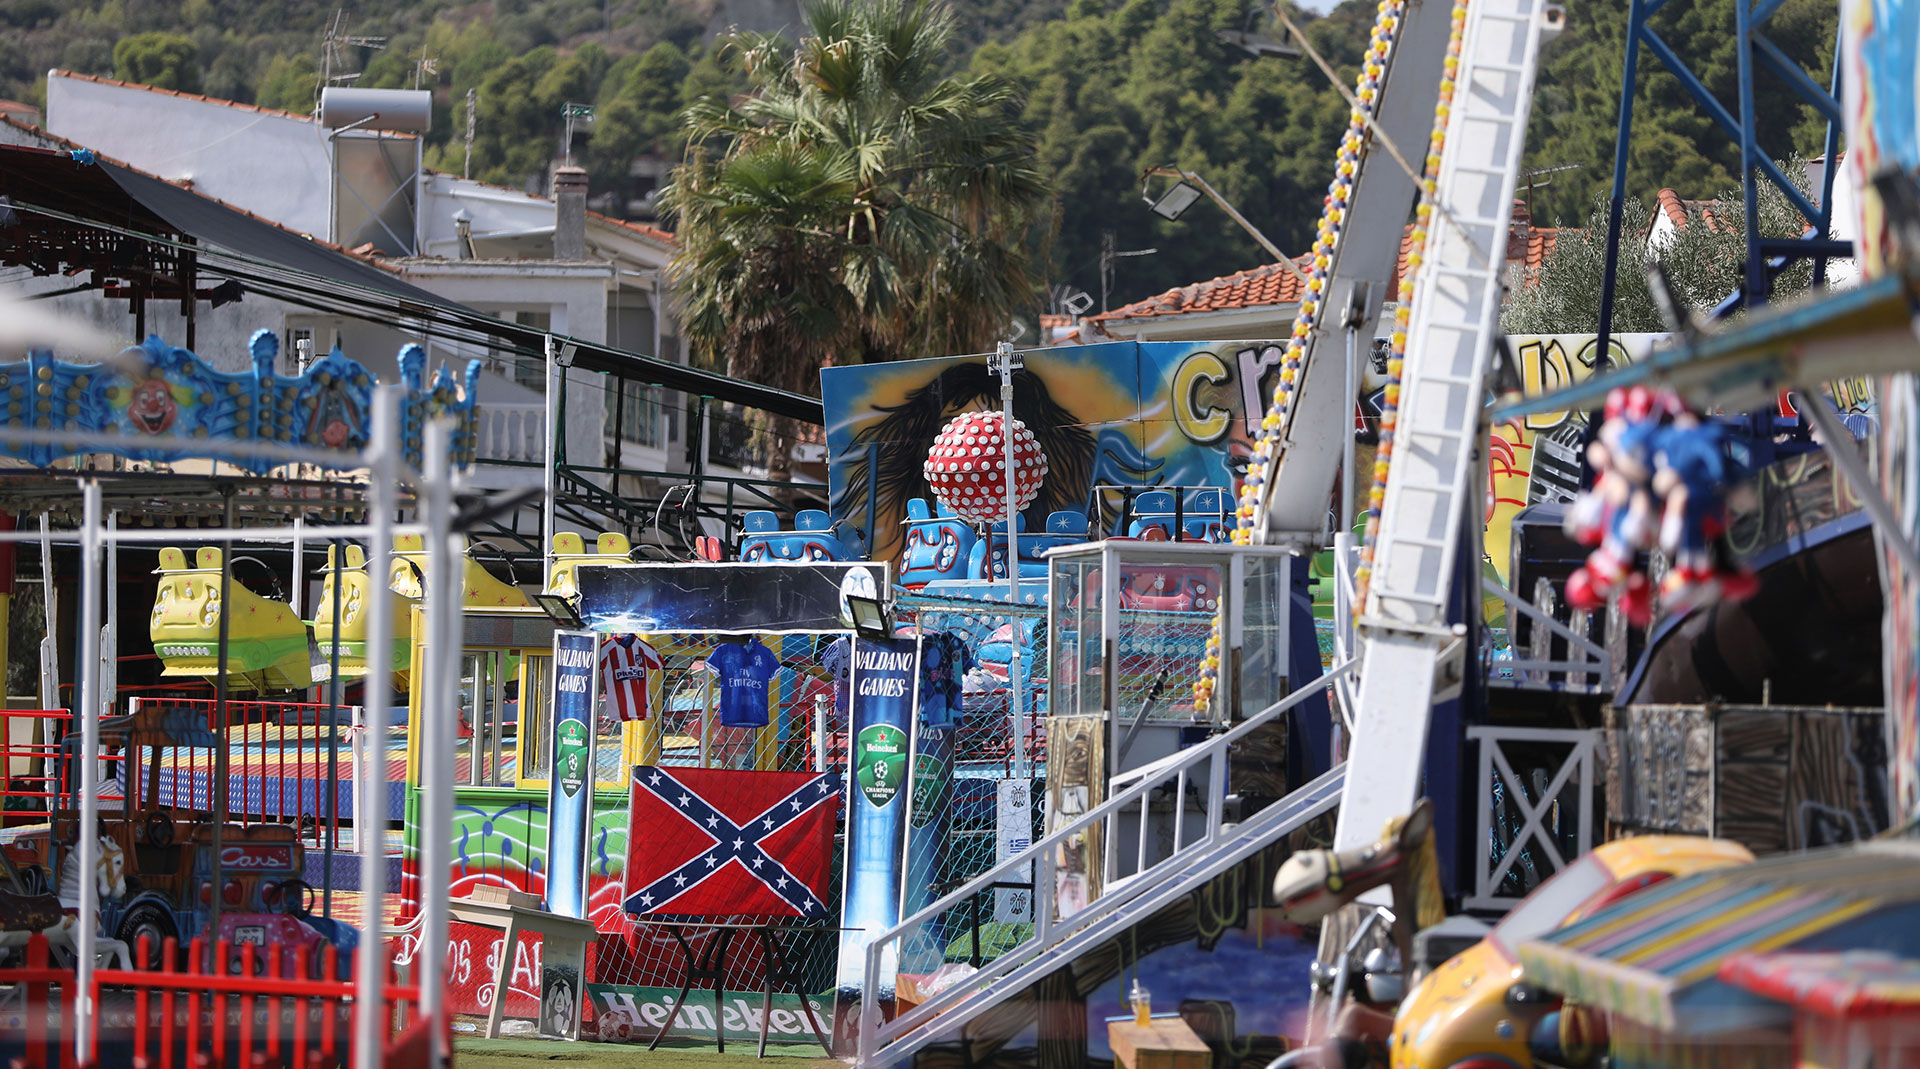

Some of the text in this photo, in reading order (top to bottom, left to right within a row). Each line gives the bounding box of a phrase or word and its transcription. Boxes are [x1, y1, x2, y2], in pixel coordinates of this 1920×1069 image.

[558, 649, 593, 668] VALDANO
[856, 651, 913, 671] VALDANO
[559, 674, 587, 693] GAMES
[859, 678, 905, 697] GAMES
[866, 743, 897, 753] Heineken
[220, 847, 288, 867] Cars
[600, 991, 833, 1035] Heineken
